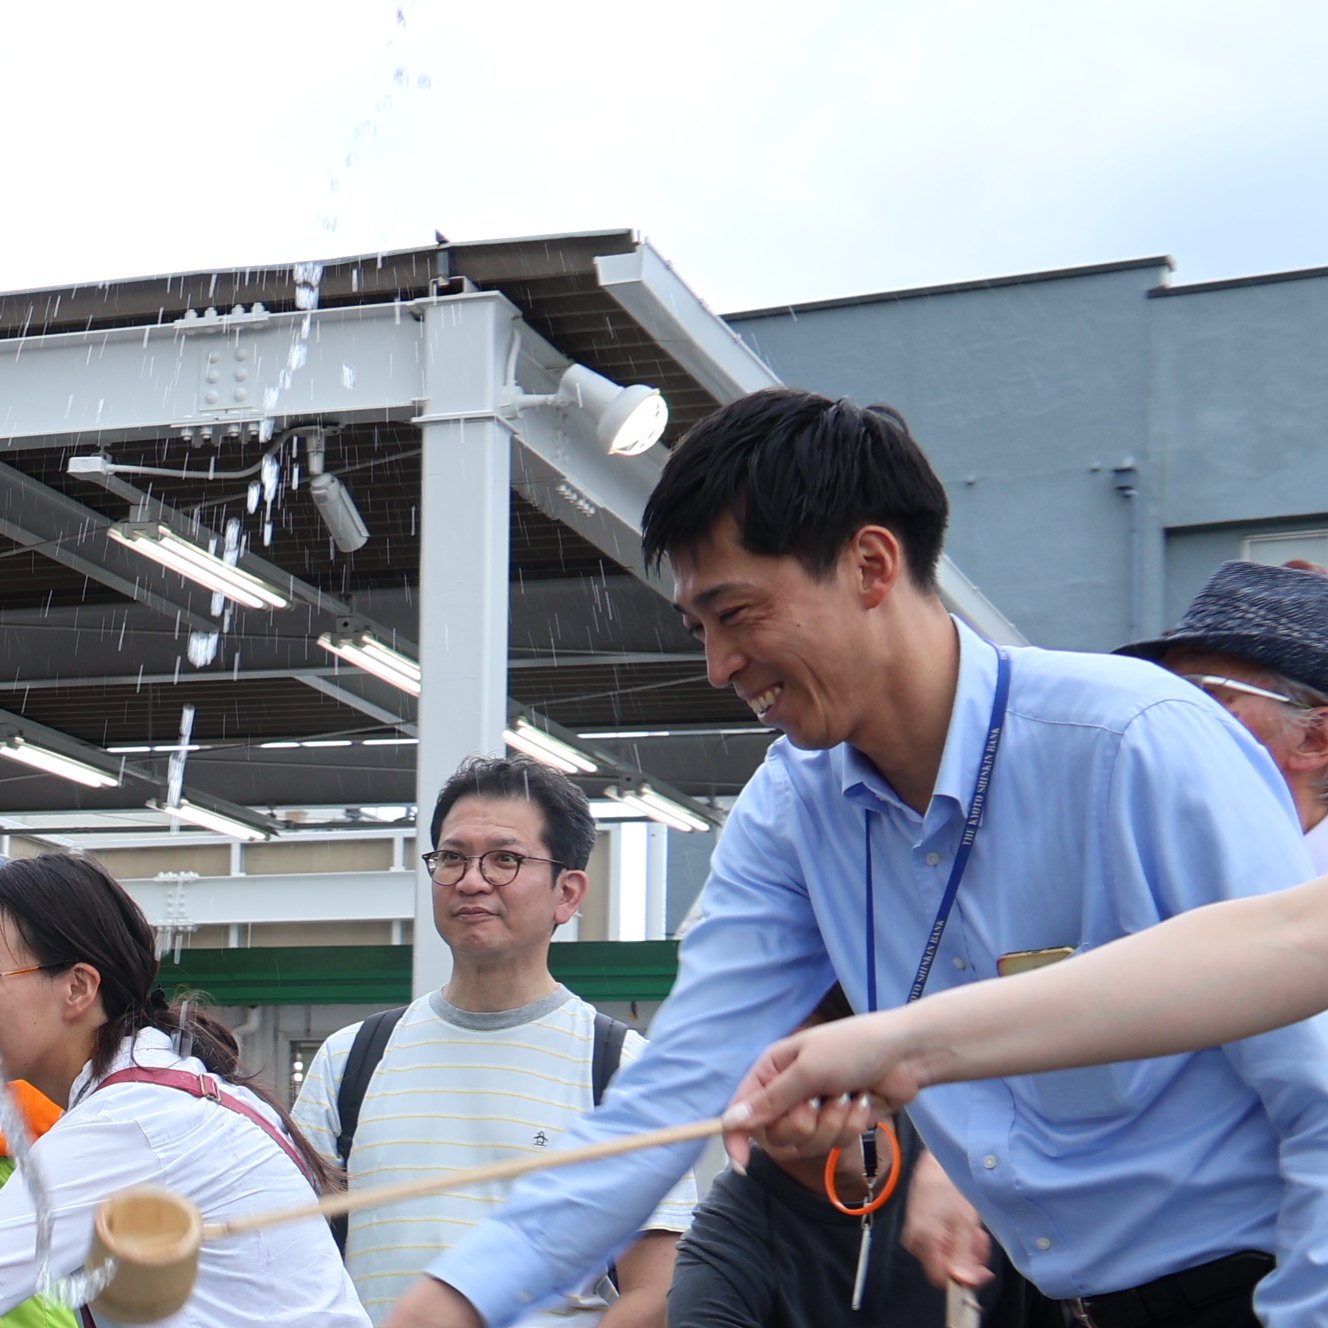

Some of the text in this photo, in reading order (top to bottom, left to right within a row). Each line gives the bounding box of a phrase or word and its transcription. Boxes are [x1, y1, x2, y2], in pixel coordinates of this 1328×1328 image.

[962, 727, 1000, 846] THE KYOTO SHINKIN BANK
[917, 945, 936, 983] SHINKIN
[929, 920, 945, 945] BANK
